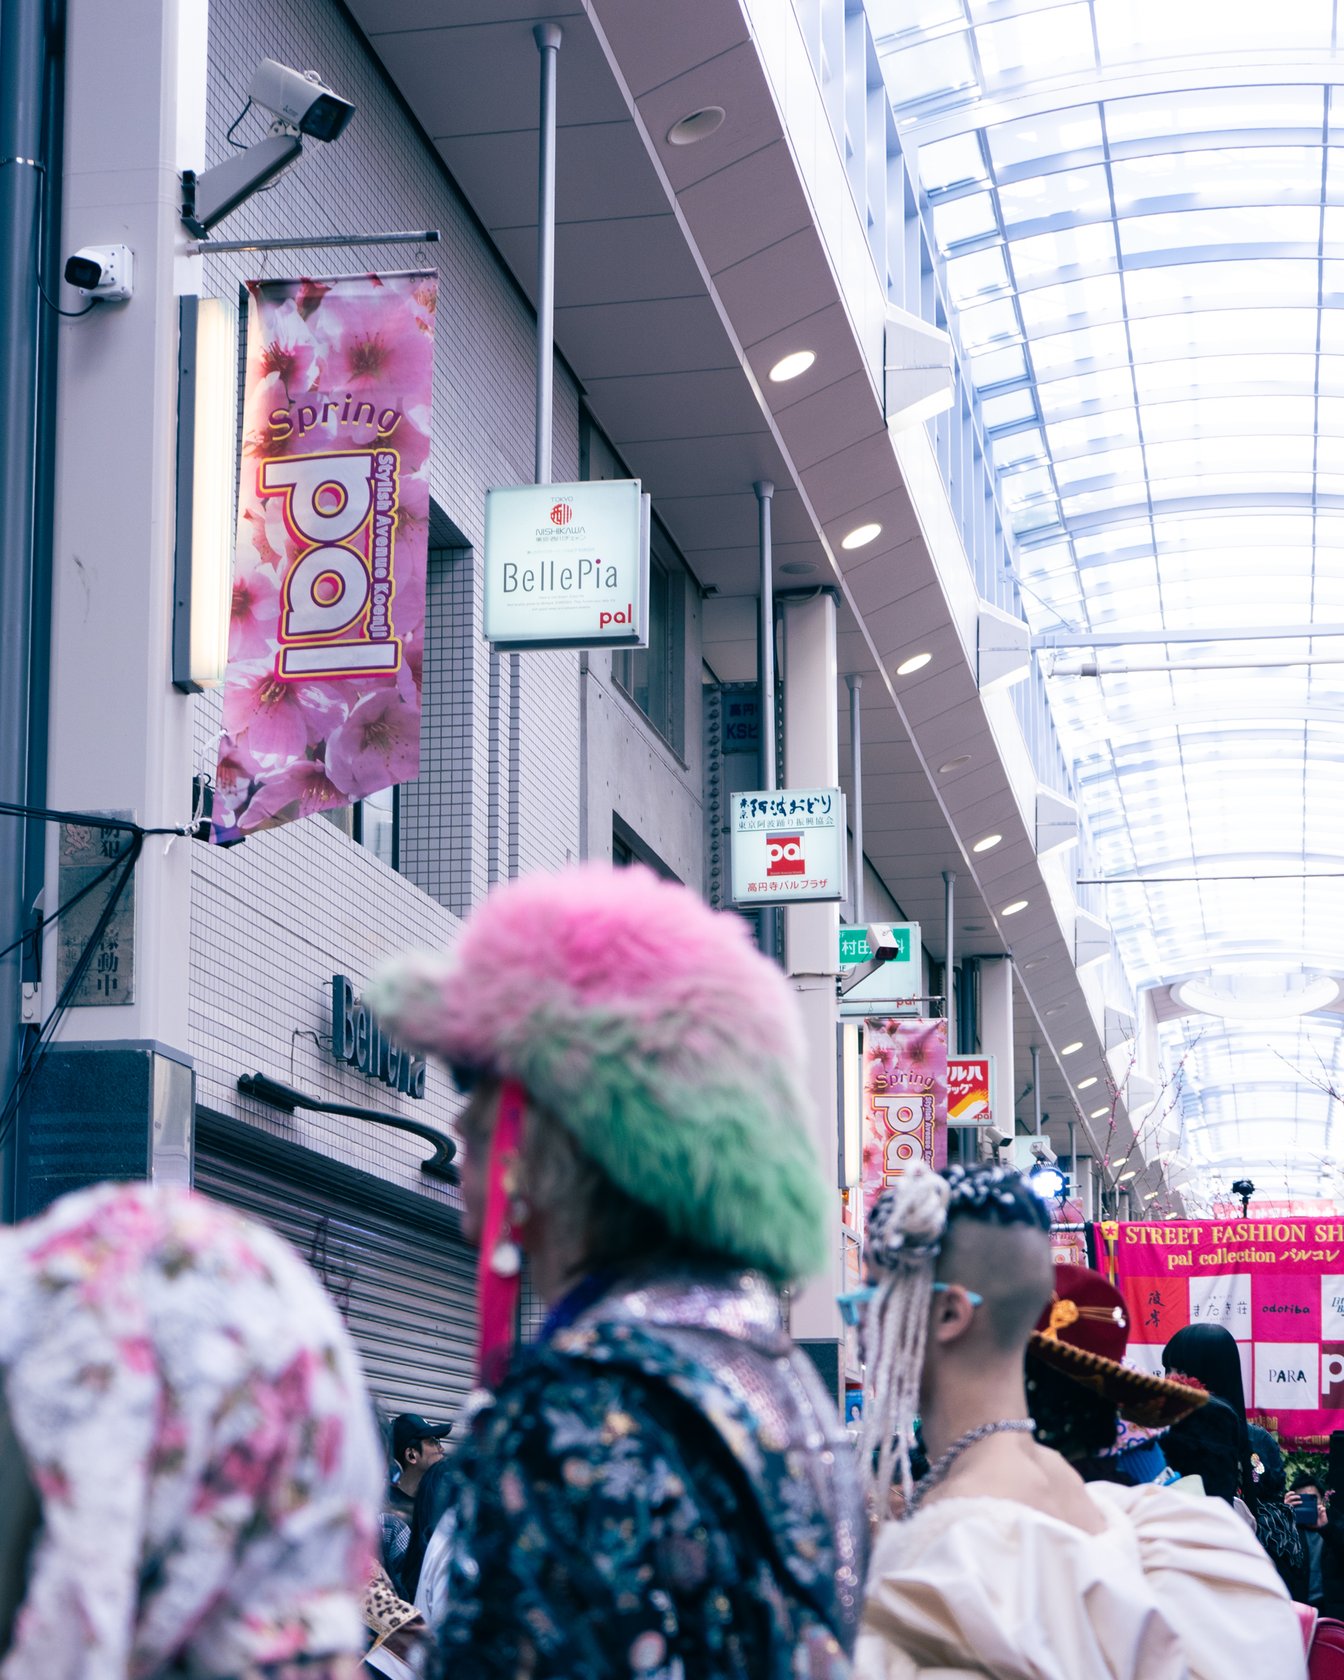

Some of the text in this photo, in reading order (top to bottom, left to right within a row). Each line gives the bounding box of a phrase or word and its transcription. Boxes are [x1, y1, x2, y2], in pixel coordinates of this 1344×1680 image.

[268, 394, 402, 441] Spring
[551, 495, 574, 503] TOKYO
[535, 526, 586, 536] NISHIKAWA
[369, 453, 395, 638] Stylish Avenue Koenji
[259, 450, 401, 678] pal
[503, 558, 618, 593] BellePia
[599, 603, 632, 629] pal
[875, 1070, 935, 1090] Spring
[947, 1065, 984, 1082] ルハ
[977, 1110, 993, 1122] pal
[1125, 1226, 1203, 1245] STREET
[1211, 1223, 1307, 1244] FASHION
[1167, 1247, 1340, 1270] pal collection パルコレ
[1262, 1303, 1310, 1315] odoriba
[1268, 1369, 1307, 1383] PARA
